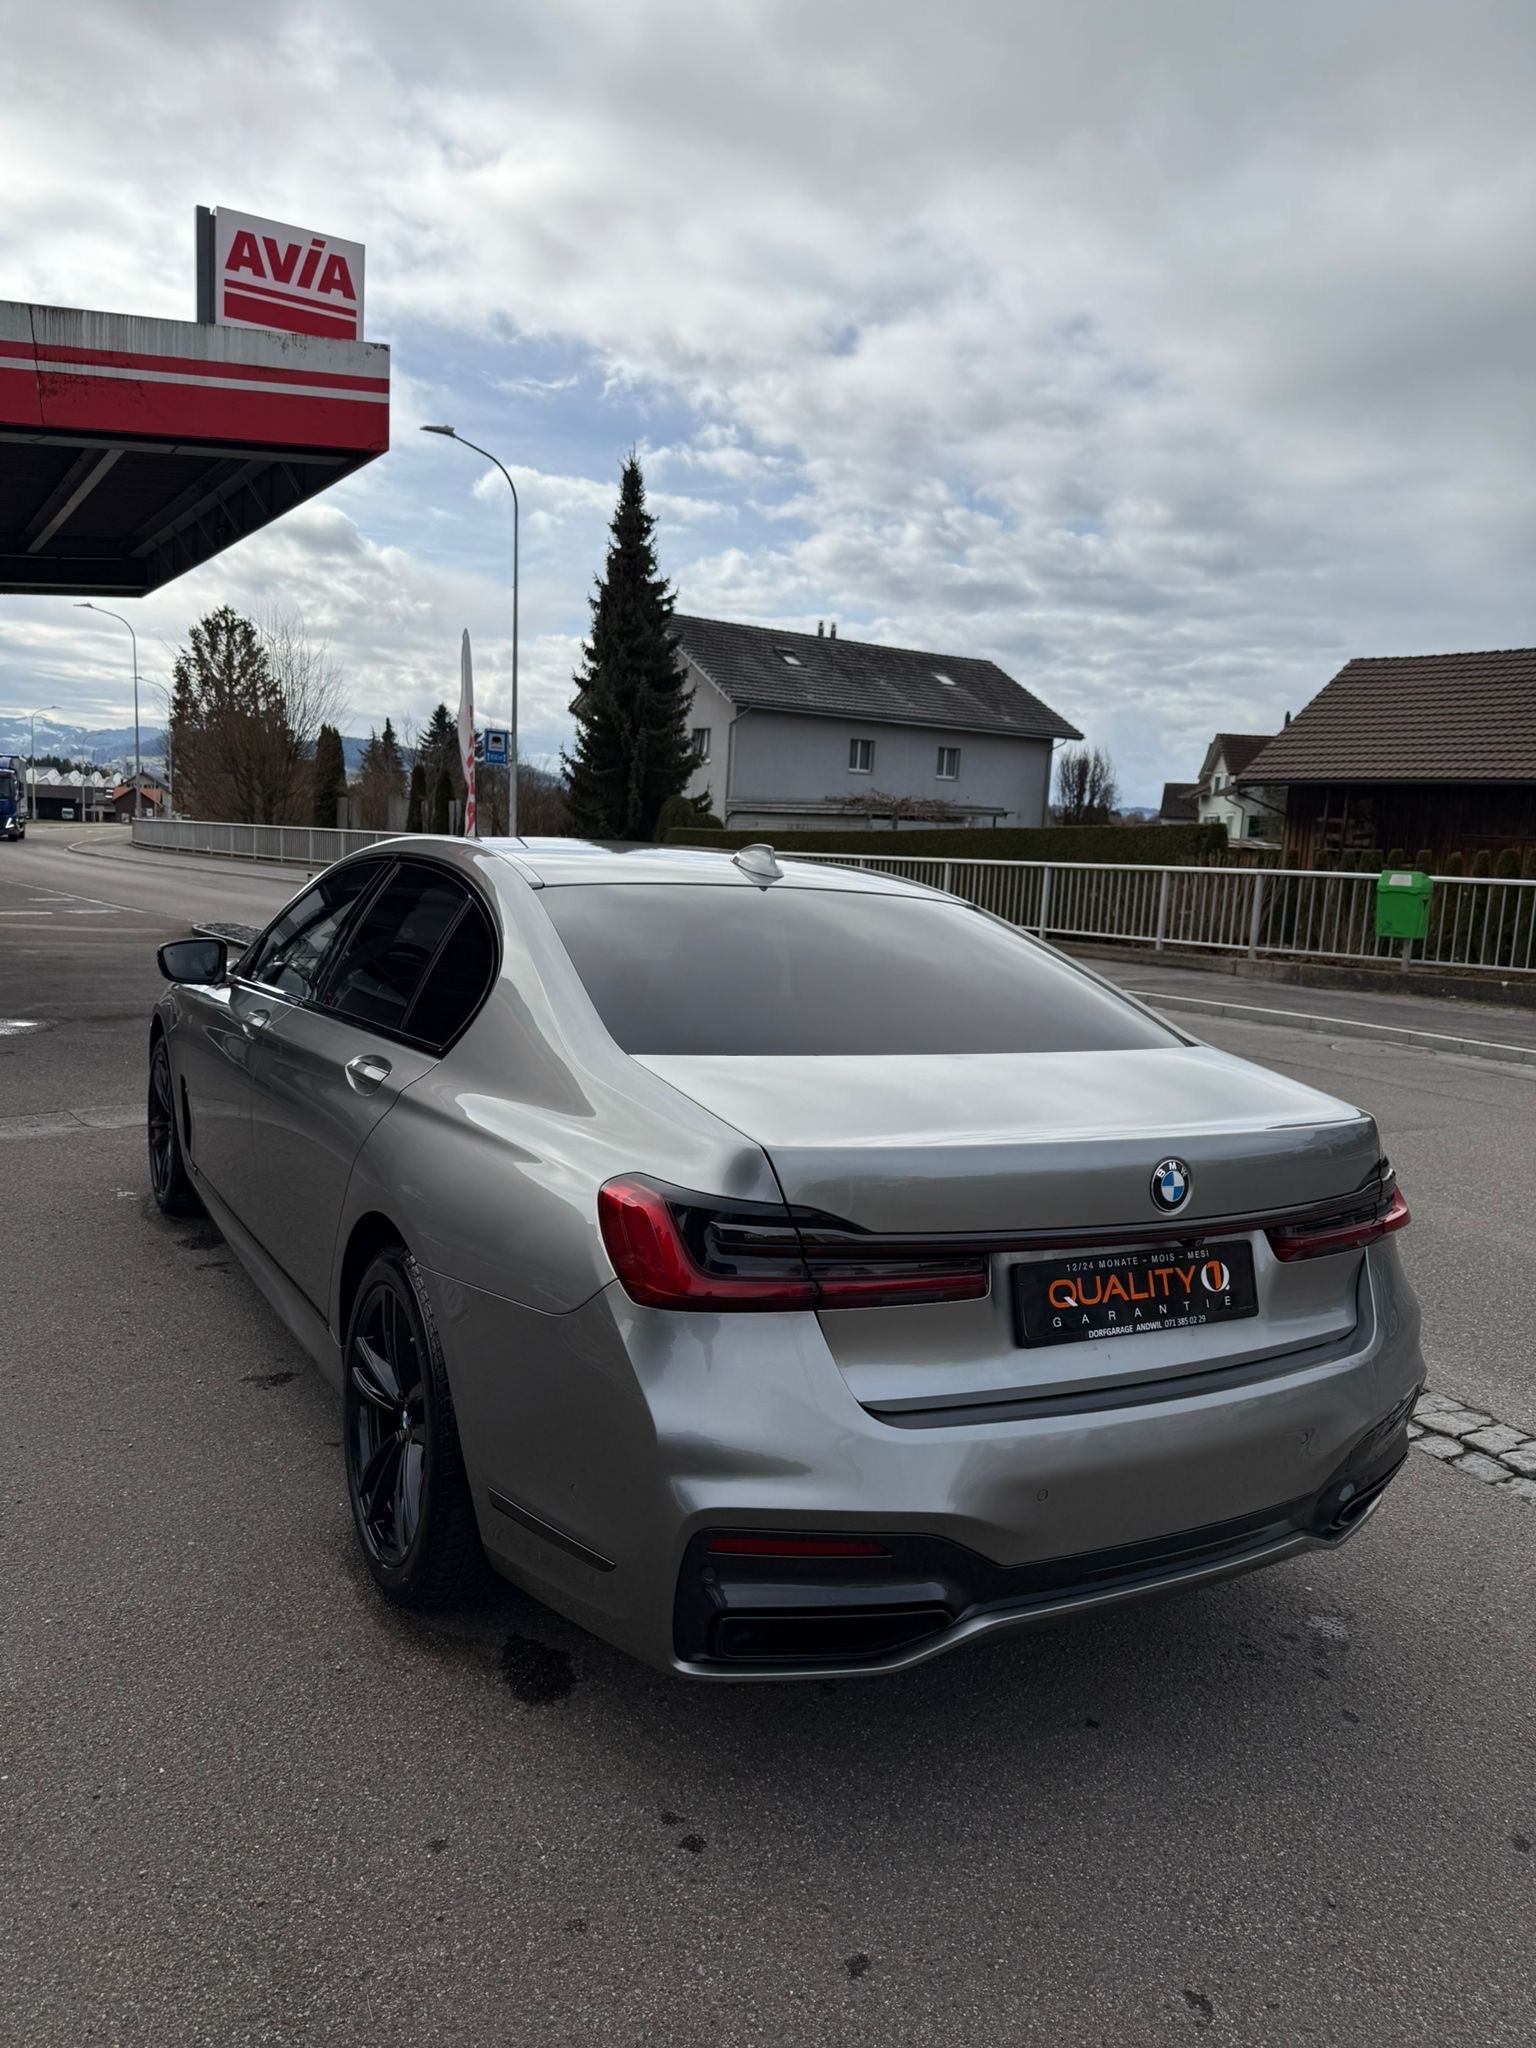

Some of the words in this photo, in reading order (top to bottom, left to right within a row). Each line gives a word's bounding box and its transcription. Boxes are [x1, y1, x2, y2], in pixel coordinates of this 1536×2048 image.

[1157, 1162, 1189, 1178] BMW
[1066, 1262, 1094, 1272] 12/24
[1099, 1257, 1138, 1269] MONATE
[1151, 1253, 1175, 1263] MOIS
[1187, 1249, 1209, 1259] MESI
[1049, 1265, 1196, 1309] QUALITY
[1053, 1296, 1231, 1327] GARANTIE
[1089, 1325, 1133, 1338] DORFGARAGE
[1136, 1322, 1162, 1332] ANDWIL
[1164, 1319, 1176, 1328] 071
[1177, 1317, 1189, 1326] 385
[1189, 1316, 1197, 1324] 02
[1198, 1315, 1206, 1323] 29
